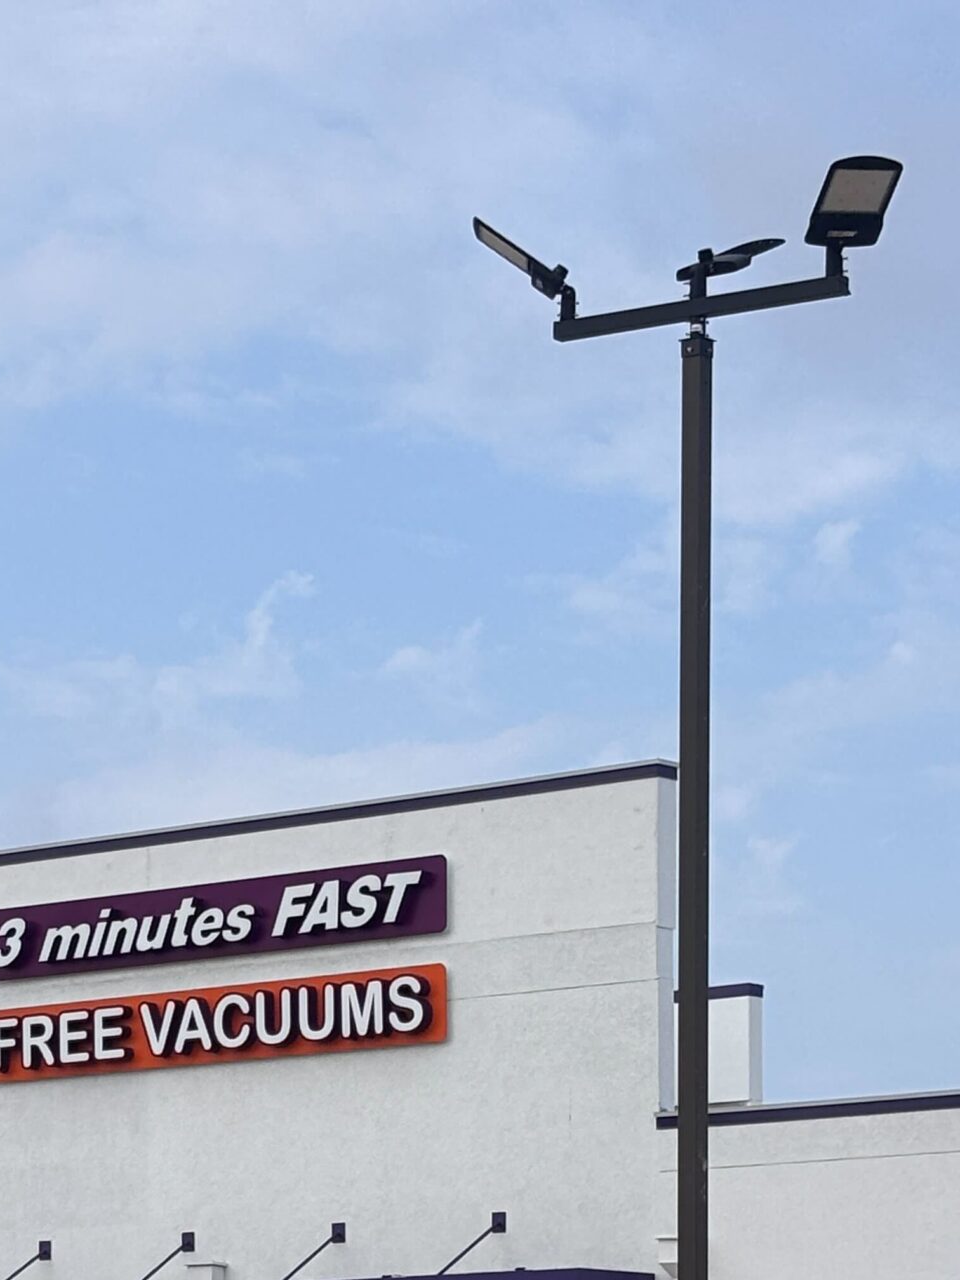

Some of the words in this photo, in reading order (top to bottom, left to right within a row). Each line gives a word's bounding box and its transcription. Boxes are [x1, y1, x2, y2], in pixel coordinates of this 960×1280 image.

[39, 897, 254, 963] minutes
[270, 870, 422, 938] FAST
[140, 974, 425, 1057] VACUUMS
